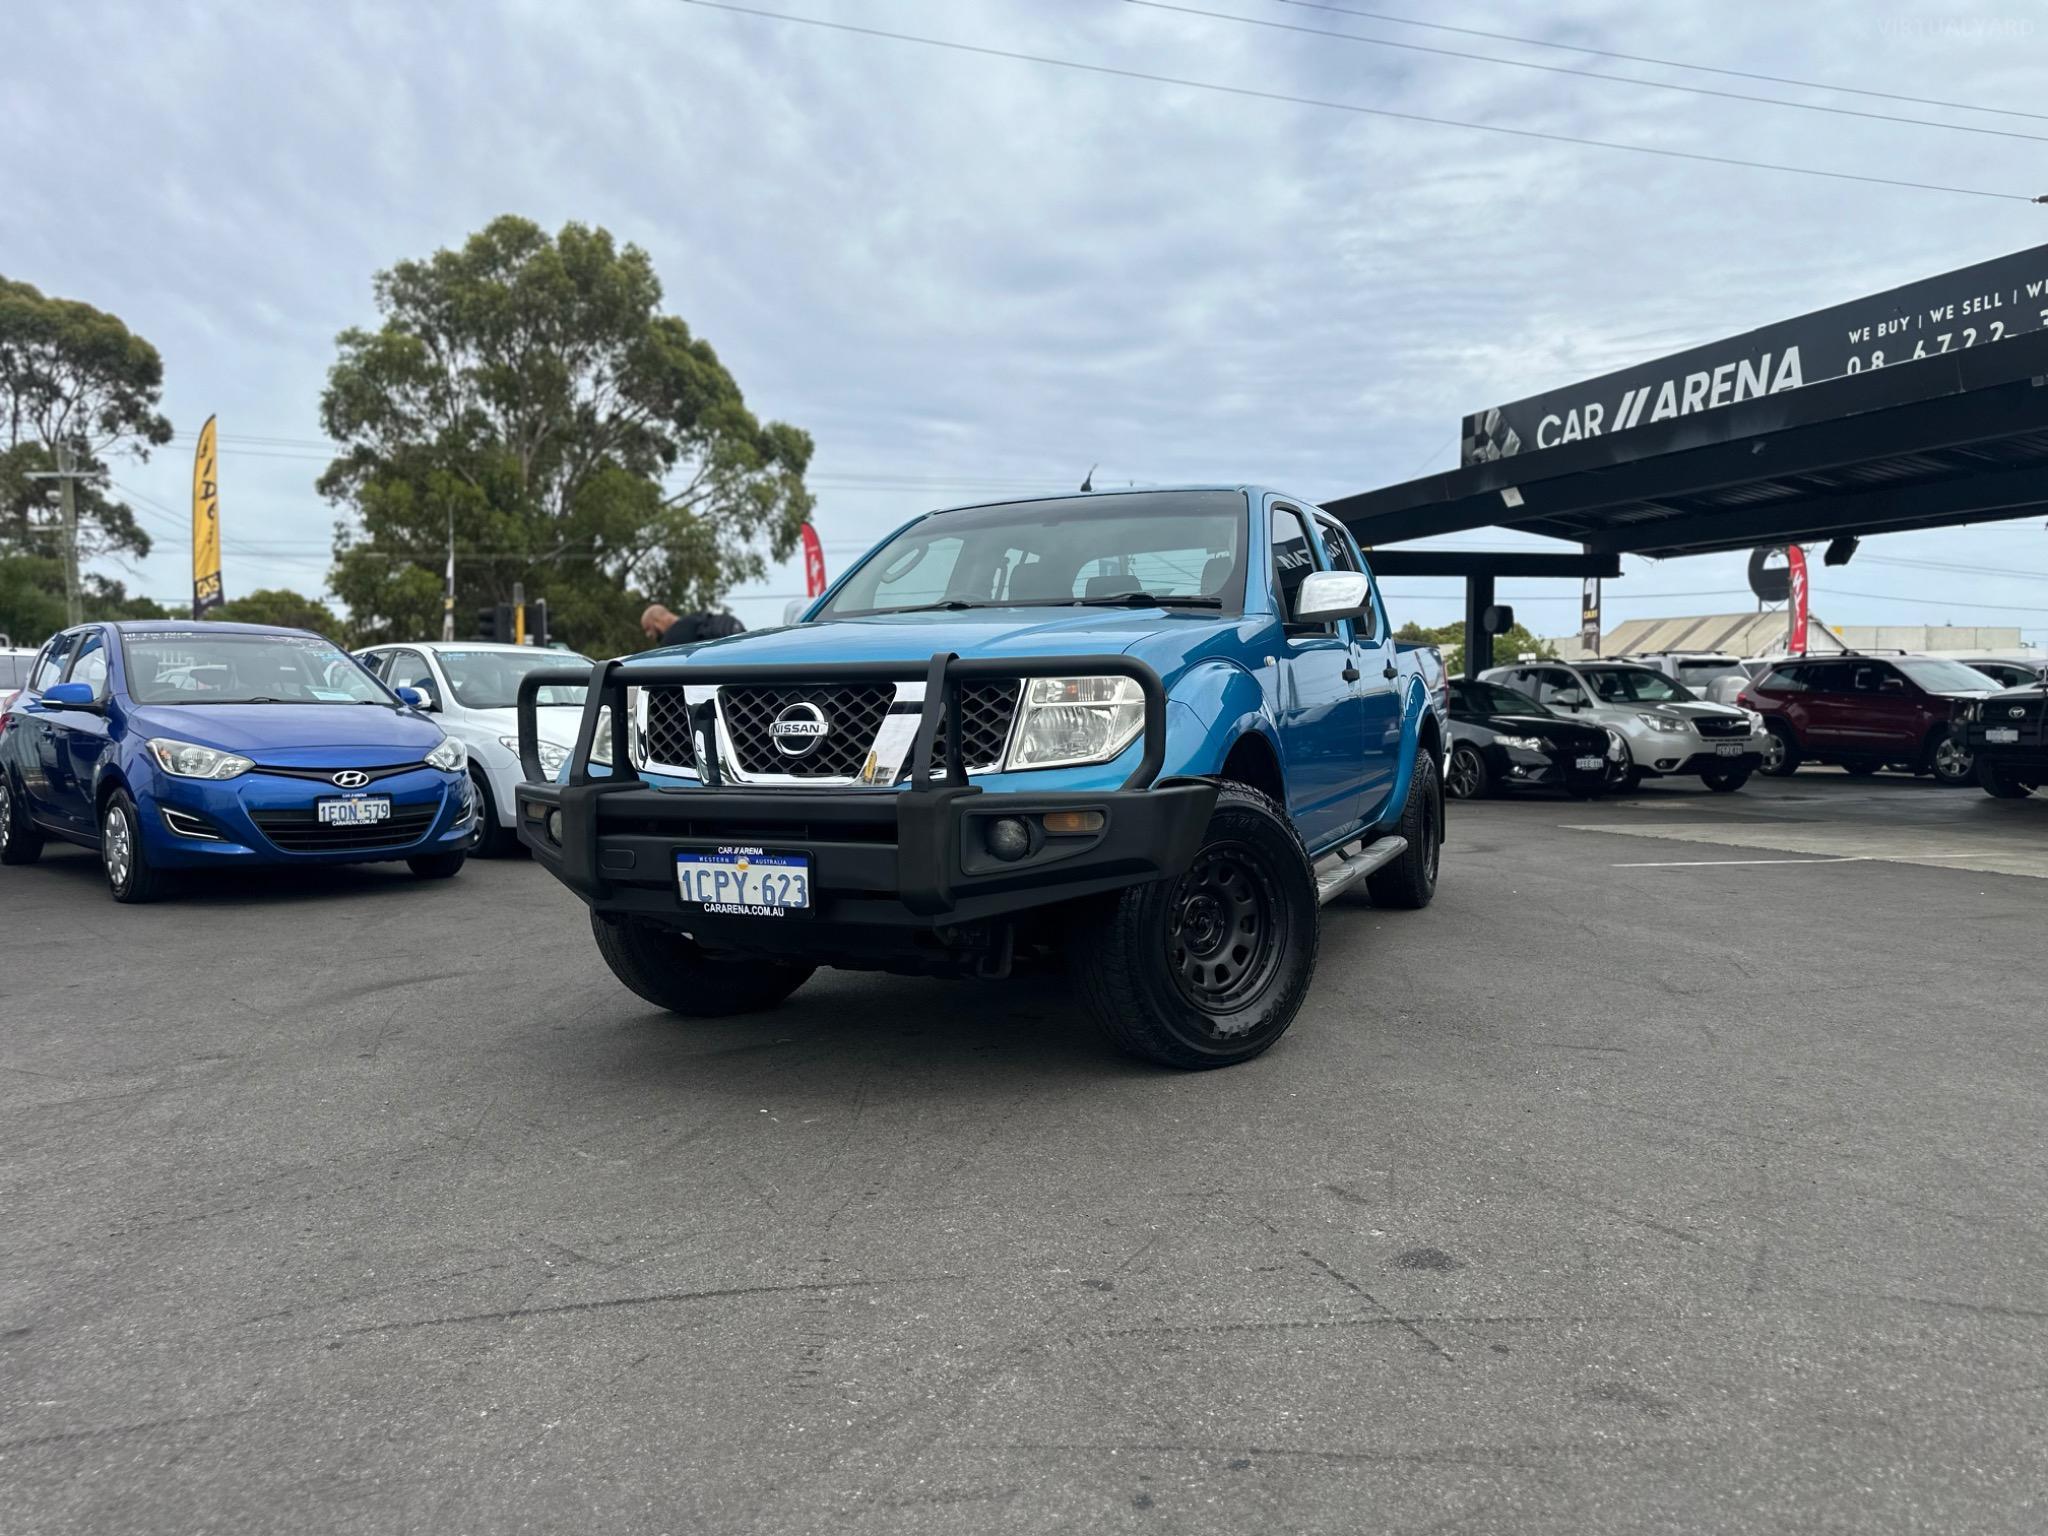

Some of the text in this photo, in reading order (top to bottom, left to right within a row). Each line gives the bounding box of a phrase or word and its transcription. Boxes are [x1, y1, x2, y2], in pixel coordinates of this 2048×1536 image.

[1849, 327, 1870, 344] WE
[1878, 316, 1910, 337] BUY
[1930, 305, 1954, 323] WE
[1962, 292, 2002, 315] SELL
[1537, 402, 1604, 449] CAR
[773, 724, 820, 733] NISSAN
[718, 846, 733, 854] CAR
[703, 903, 784, 917] CARARENA.COM.AU
